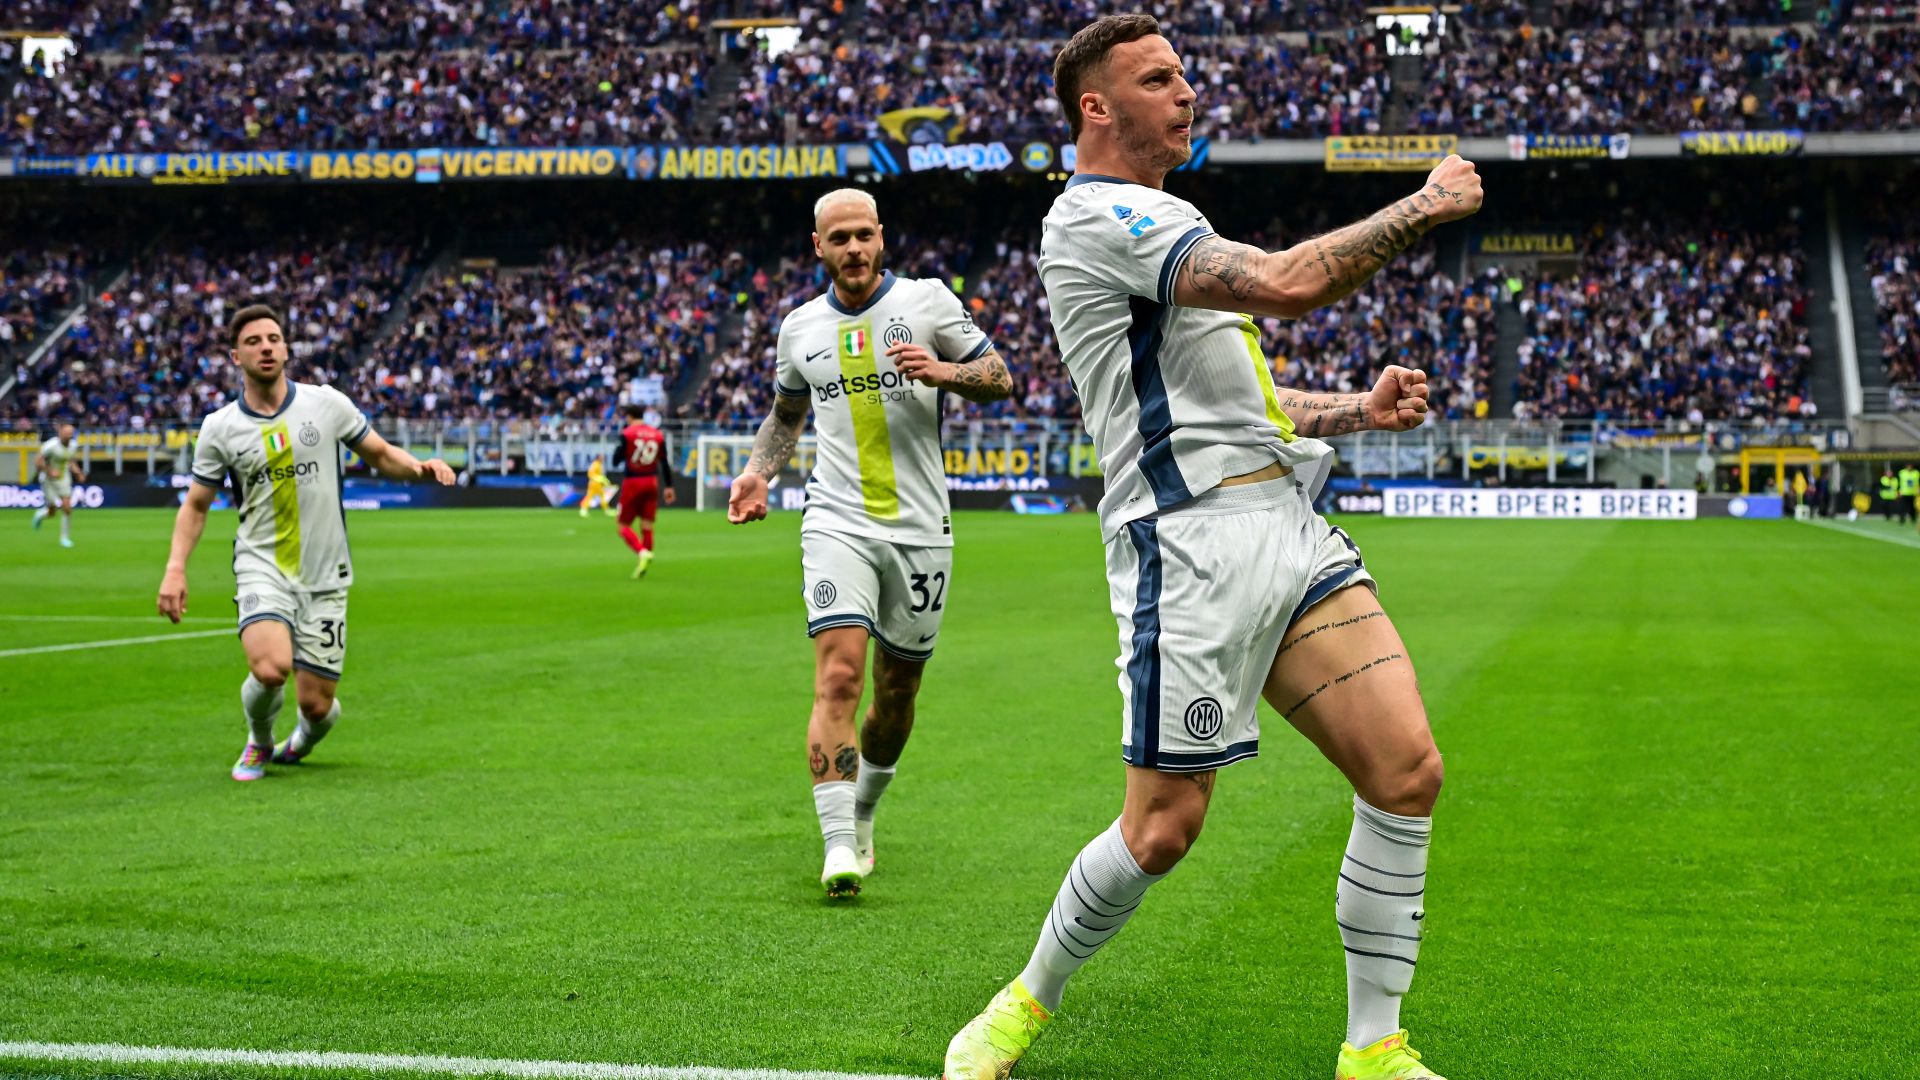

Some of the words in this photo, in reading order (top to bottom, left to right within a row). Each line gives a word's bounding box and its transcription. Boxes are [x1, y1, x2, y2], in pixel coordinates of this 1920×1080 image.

[166, 152, 290, 177] POLESINE
[310, 152, 414, 179] BASSO
[442, 149, 616, 177] VICENTINO
[660, 147, 838, 178] AMBROSIANA
[1482, 234, 1574, 253] ALTAVILLA
[944, 449, 1030, 475] BANO
[1394, 494, 1478, 513] BPER:
[1497, 494, 1581, 513] BPER:
[910, 570, 945, 613] 32
